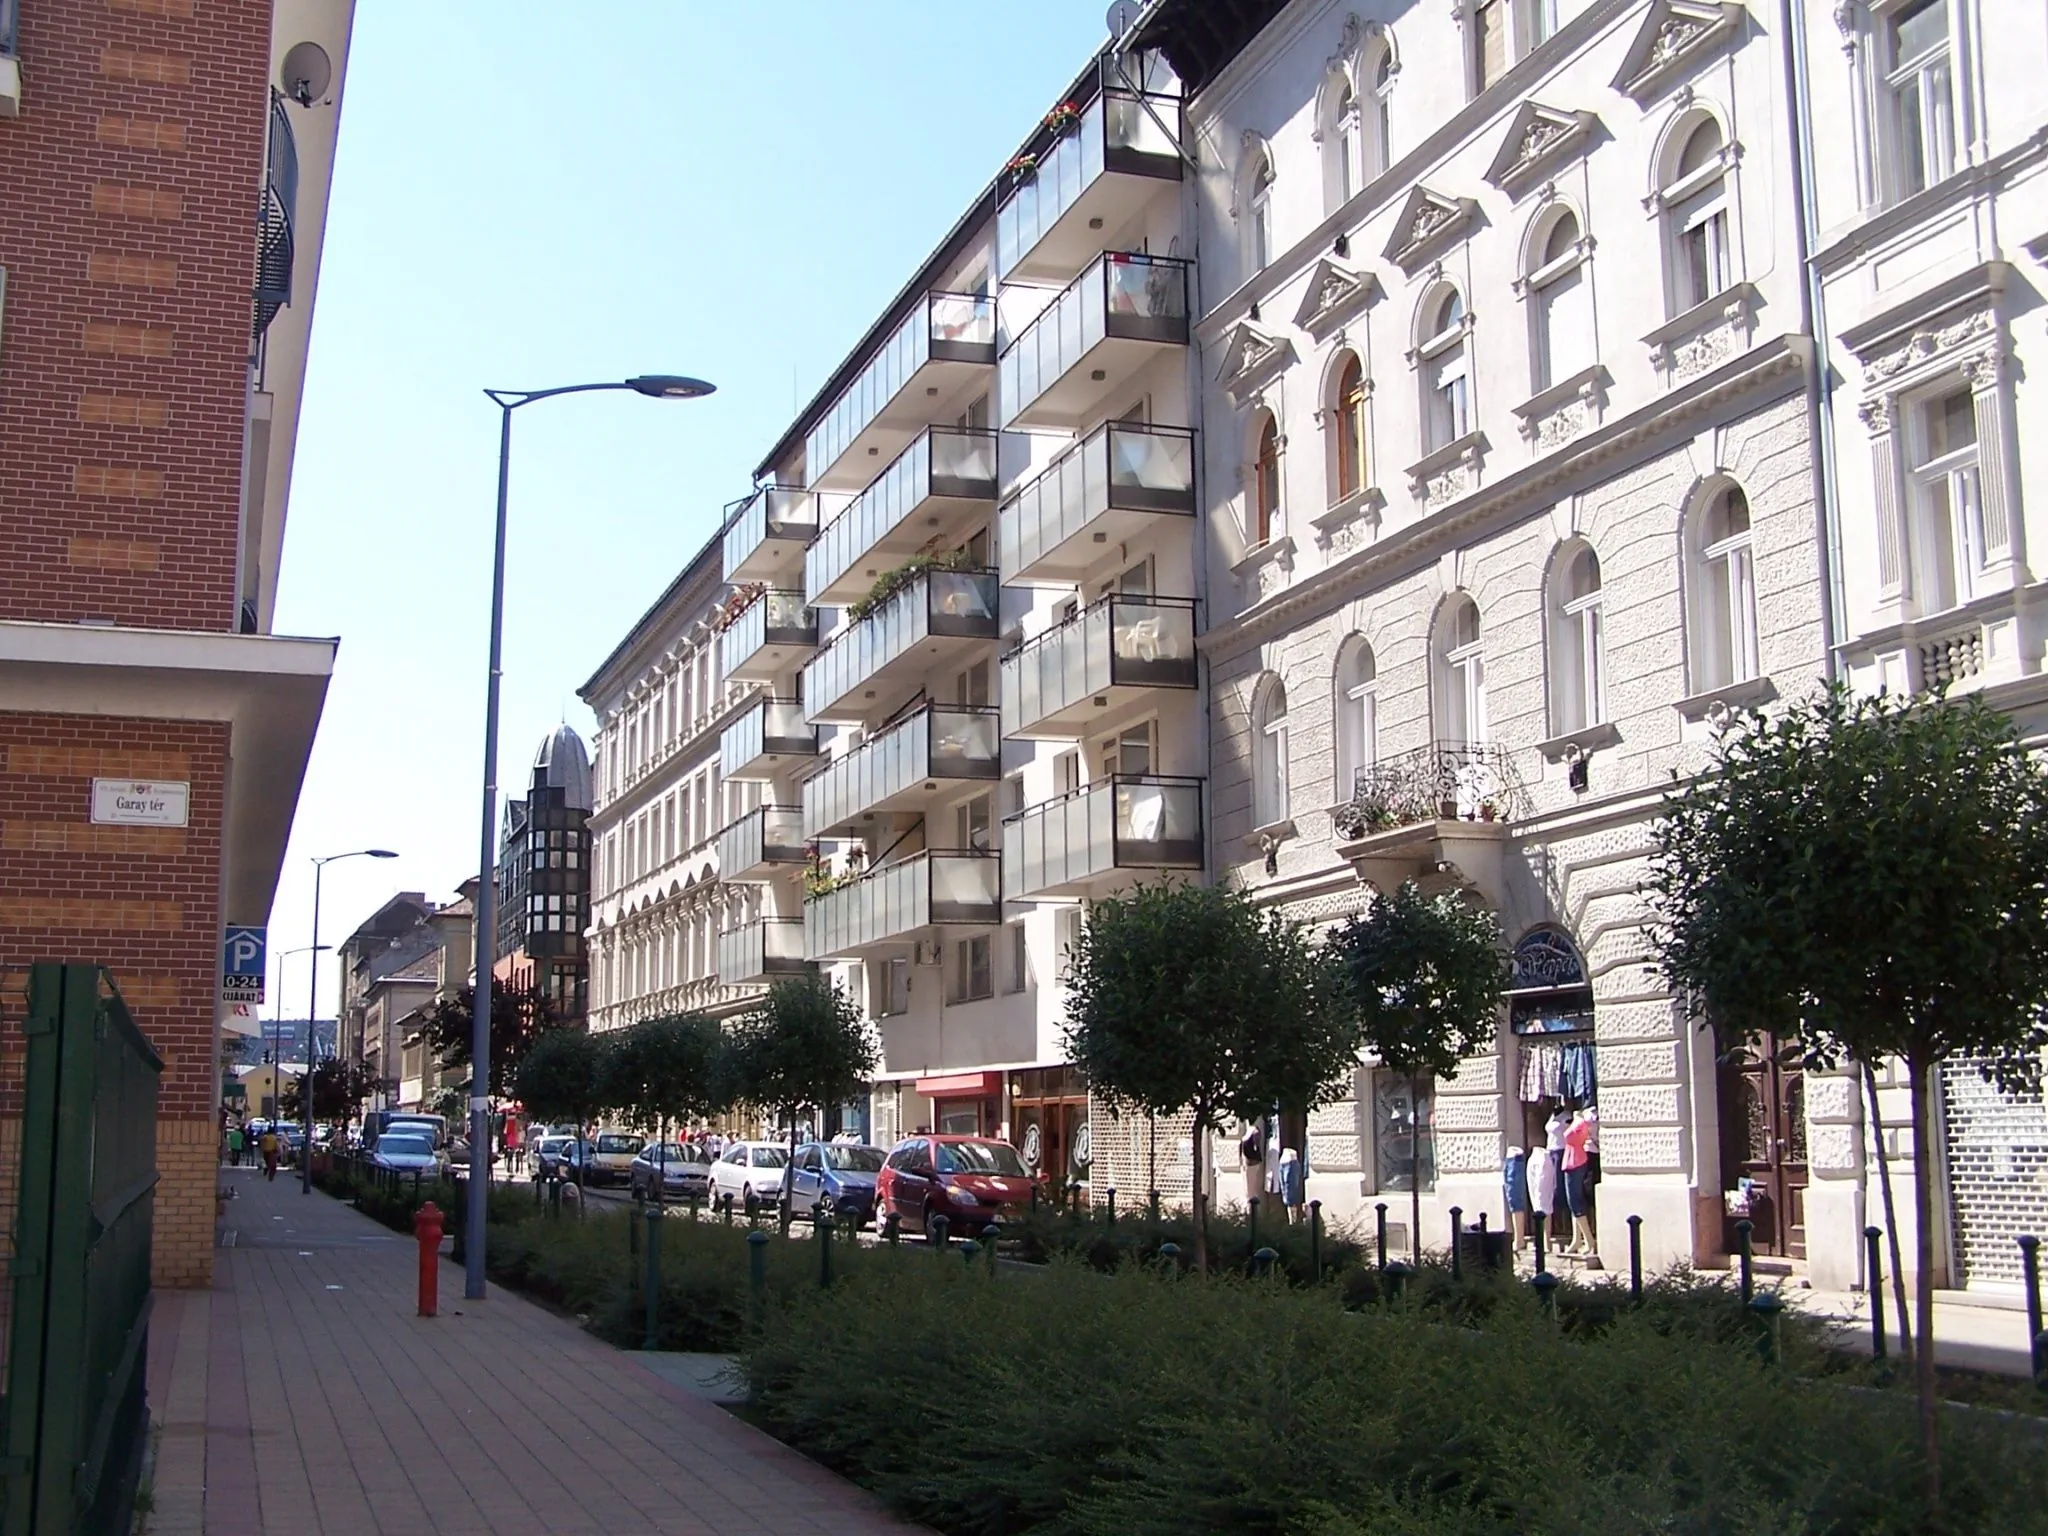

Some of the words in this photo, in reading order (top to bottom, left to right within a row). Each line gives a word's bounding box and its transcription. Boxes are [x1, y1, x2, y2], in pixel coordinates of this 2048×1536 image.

[116, 796, 147, 813] Garay
[150, 798, 165, 811] tér
[233, 940, 257, 972] P
[226, 976, 258, 988] 0-24
